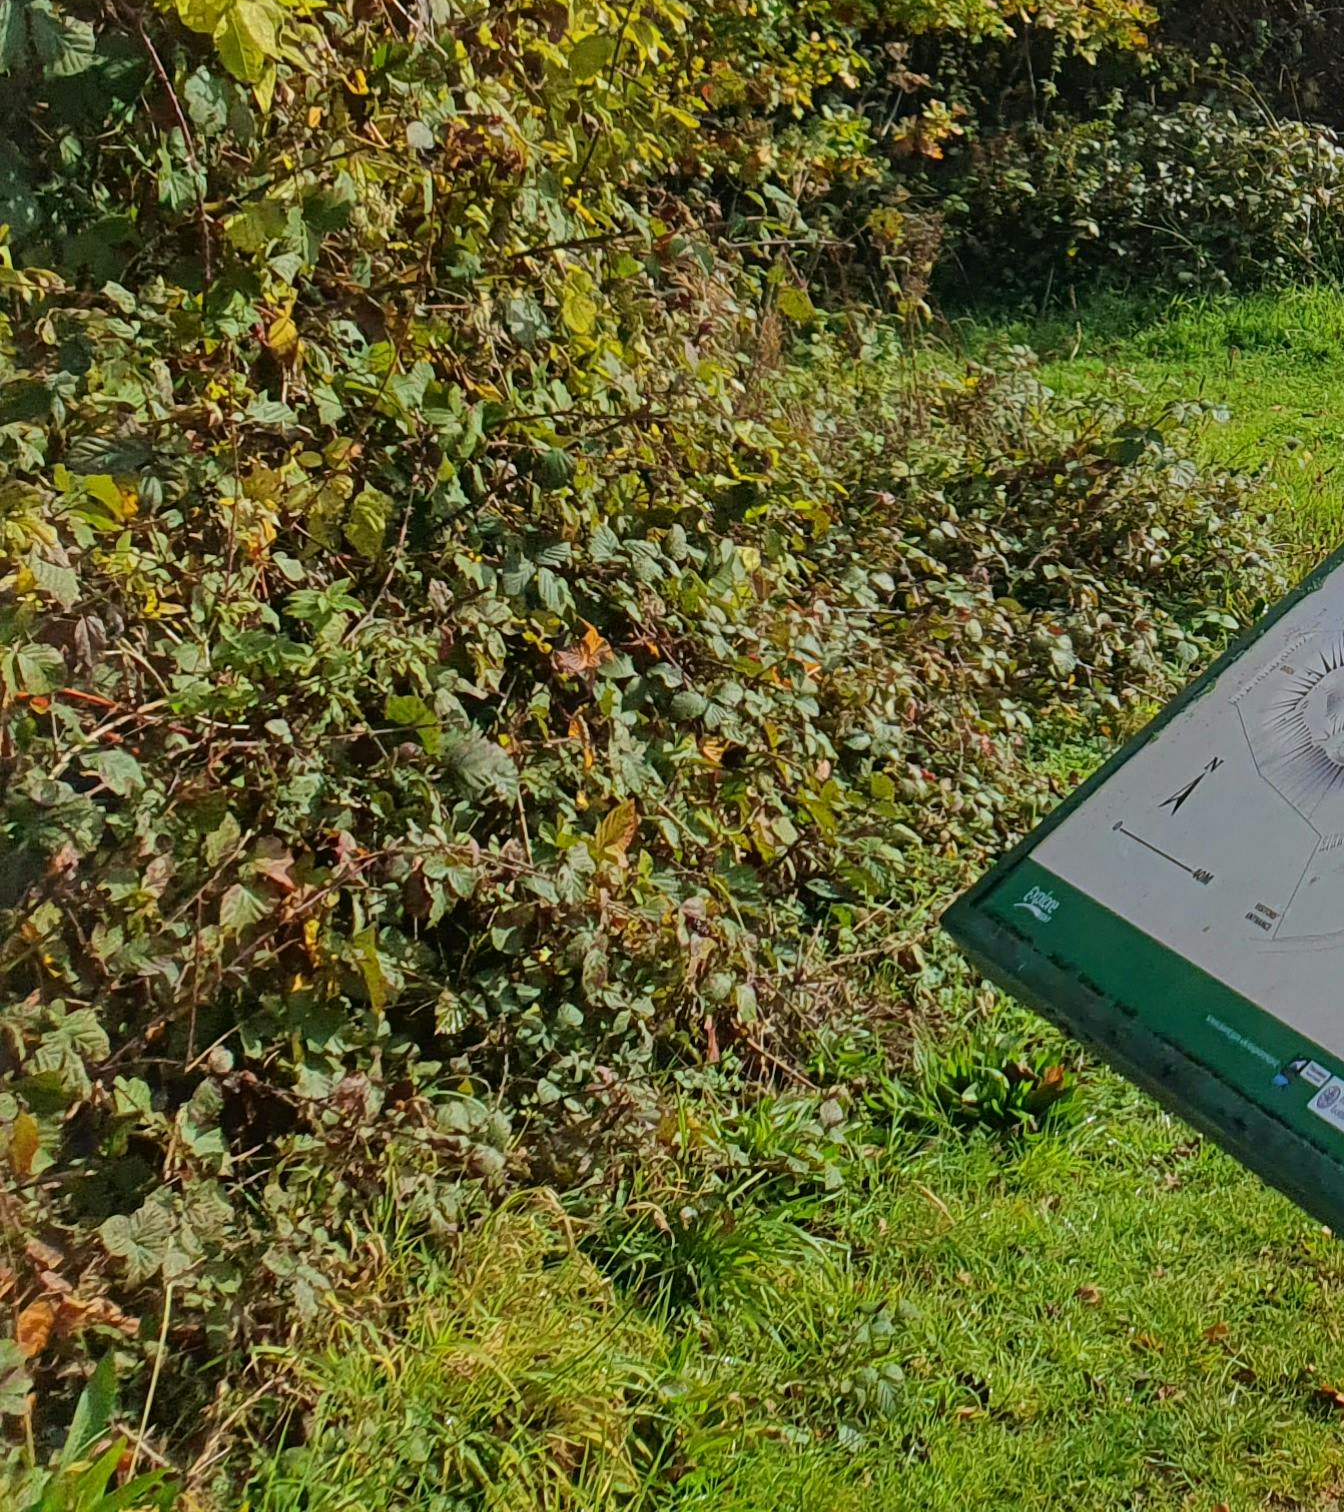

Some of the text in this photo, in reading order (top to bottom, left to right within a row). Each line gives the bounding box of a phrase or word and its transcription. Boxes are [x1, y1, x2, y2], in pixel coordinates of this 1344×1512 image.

[1204, 756, 1225, 773] N
[1193, 868, 1215, 885] 40M
[1024, 885, 1060, 914] Explore
